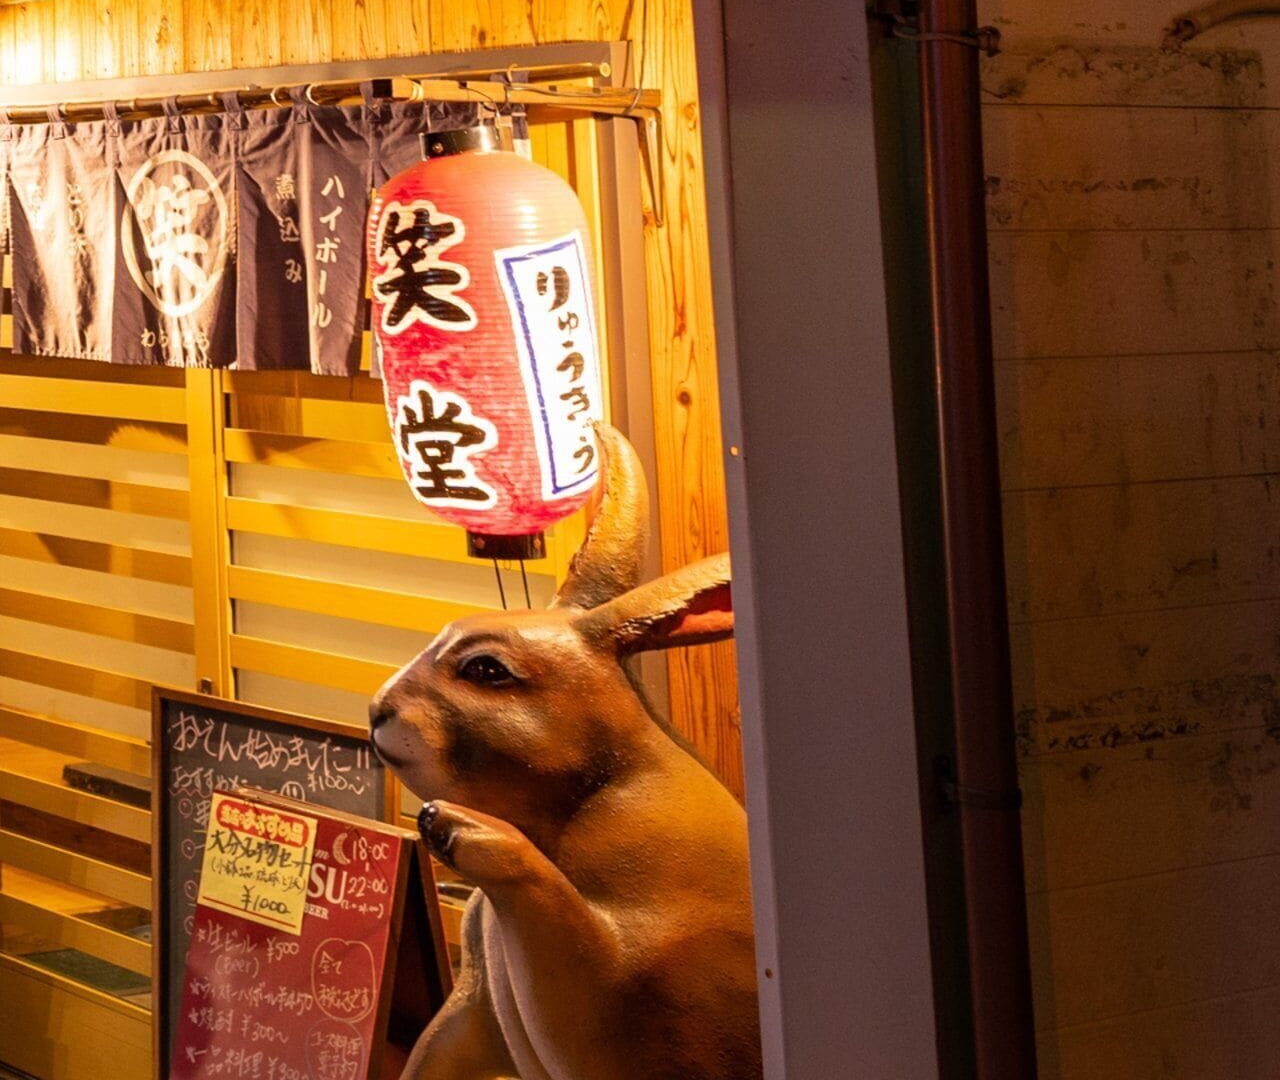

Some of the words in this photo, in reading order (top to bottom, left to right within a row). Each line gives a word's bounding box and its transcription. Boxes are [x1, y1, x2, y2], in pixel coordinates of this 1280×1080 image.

[275, 173, 303, 284] 煮込み
[313, 174, 345, 329] ハイボール
[376, 207, 490, 501] 笑堂
[536, 265, 595, 473] りゅうきう
[241, 885, 291, 914] ¥1000
[266, 936, 300, 963] ¥500
[318, 950, 342, 975] 全て
